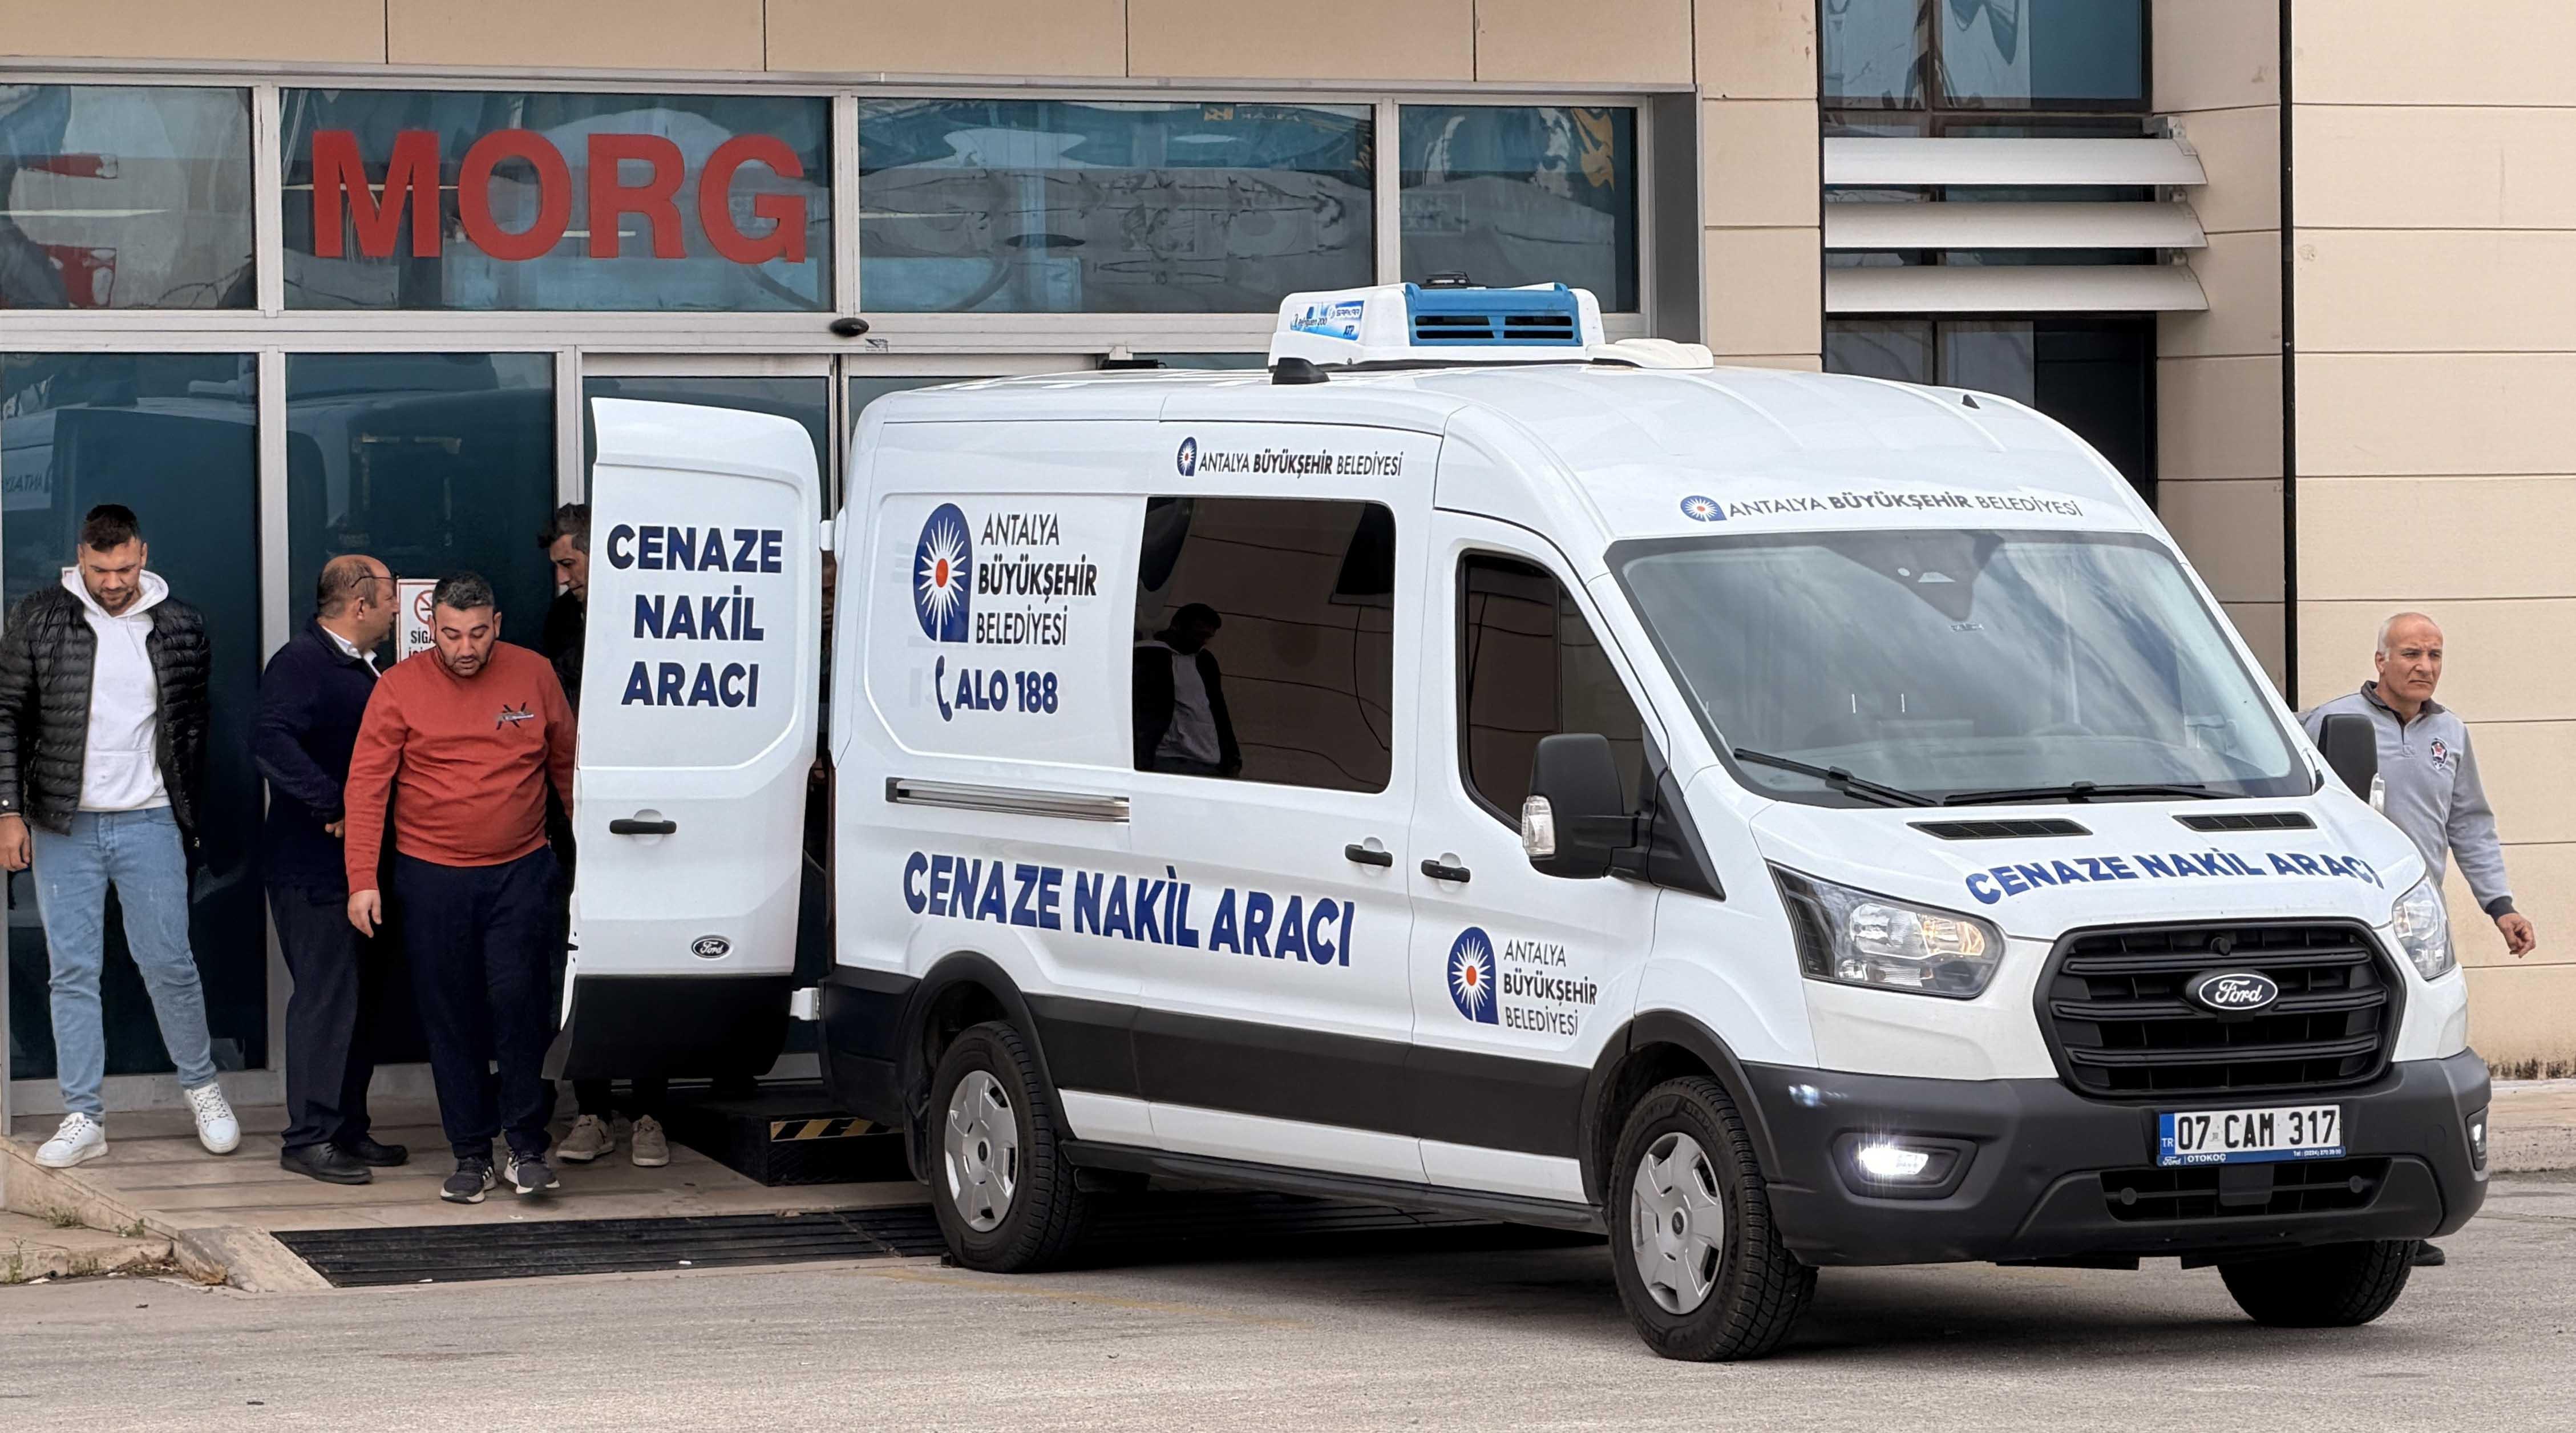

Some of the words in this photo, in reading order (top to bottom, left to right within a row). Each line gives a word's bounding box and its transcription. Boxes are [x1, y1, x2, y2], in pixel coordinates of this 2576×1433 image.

[312, 129, 806, 264] MORG
[1198, 452, 1249, 473] ANTALYA
[1253, 449, 1333, 479] BÜYÜKŞEHİR
[1336, 451, 1404, 477] BELEDİYESİ
[1729, 496, 1827, 518] ANTALYA
[1829, 491, 1974, 511] BÜYÜKŞEHİR
[1975, 495, 2083, 516] BELEDİYESİ
[607, 524, 783, 574] CENAZE
[981, 512, 1059, 547] ANTALYA
[977, 553, 1098, 604] BÜYÜKŞEHİR
[633, 585, 764, 641] NAKİL
[976, 604, 1068, 645] BELEDİYESİ
[621, 661, 759, 708] ARACI
[955, 669, 1009, 712] ALO
[1015, 671, 1059, 715] 188
[1966, 857, 2140, 905] CENAZE
[2132, 847, 2267, 878] NAKİL
[2265, 853, 2384, 890] ARACI
[903, 851, 1063, 931] CENAZE
[1073, 865, 1199, 949] NAKİL
[1208, 887, 1355, 967] ARACI
[699, 940, 724, 954] Ford
[1503, 939, 1566, 967] ANTALYA
[1503, 967, 1598, 1007] BÜYÜKŞEHİR
[2215, 979, 2263, 1003] Ford
[1505, 1005, 1578, 1036] BELEDİYESİ
[2161, 1137, 2174, 1147] TR
[2178, 1115, 2211, 1150] 07
[2225, 1113, 2274, 1148] CAM
[2288, 1109, 2336, 1145] 317
[2162, 1156, 2181, 1165] Ford
[2187, 1153, 2226, 1164] OTOKOÇ
